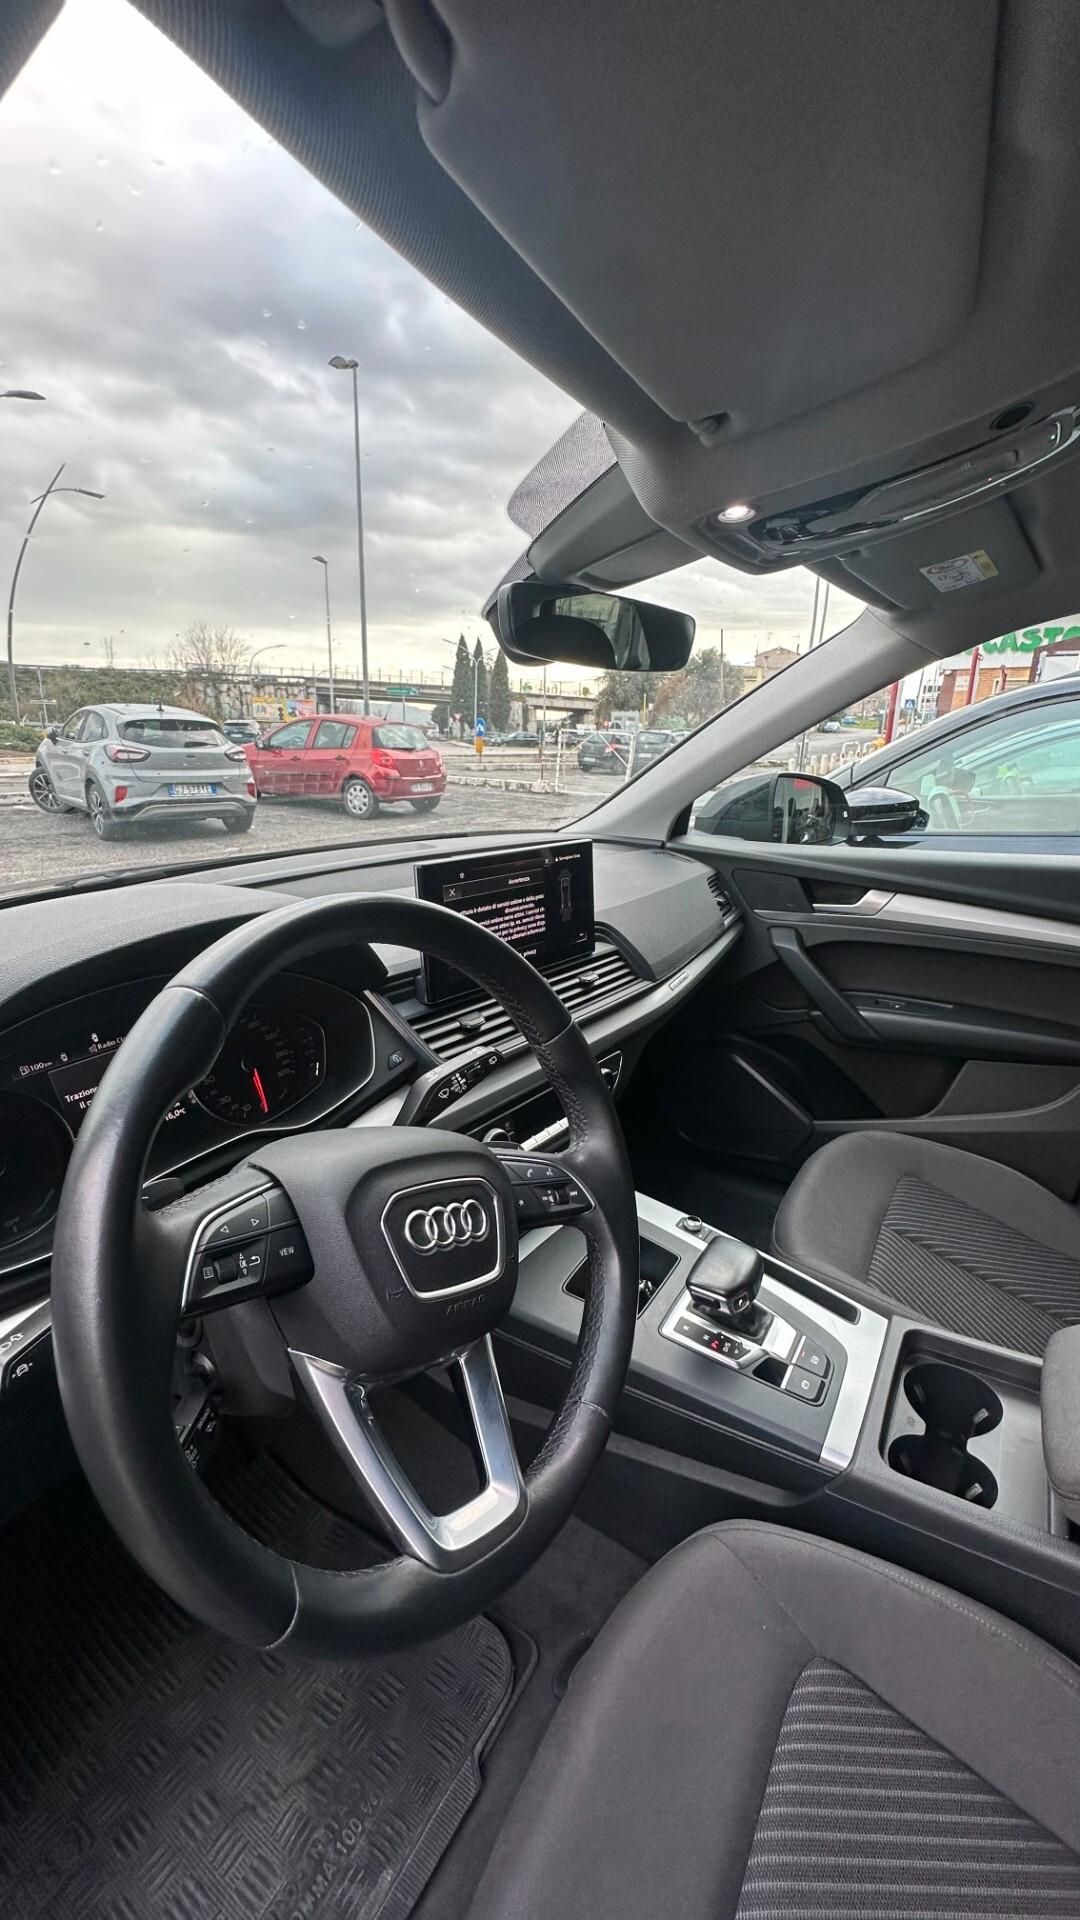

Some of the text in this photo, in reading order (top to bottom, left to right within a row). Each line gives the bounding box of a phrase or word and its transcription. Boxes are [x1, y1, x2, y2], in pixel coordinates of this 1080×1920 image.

[97, 1040, 116, 1050] Radio
[279, 1246, 295, 1256] VIEW
[290, 1861, 337, 1920] OMMA
[336, 1817, 362, 1854] 100
